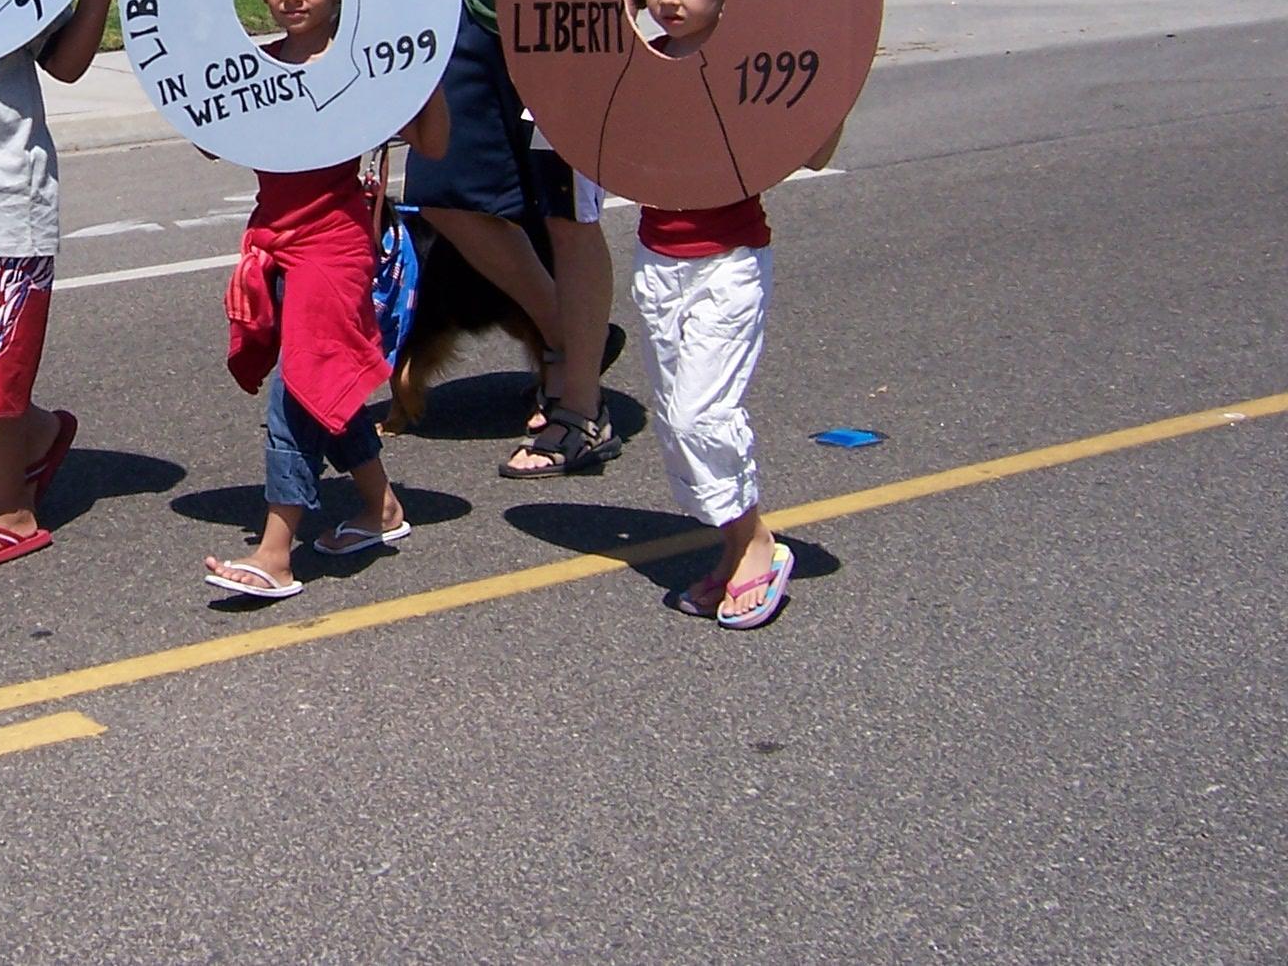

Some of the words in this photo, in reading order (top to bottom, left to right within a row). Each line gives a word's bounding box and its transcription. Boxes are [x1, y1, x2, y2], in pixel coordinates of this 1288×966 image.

[362, 28, 437, 78] 1999
[514, 1, 624, 53] LIBERTY
[157, 74, 188, 107] IN
[205, 53, 260, 90] GOD
[183, 95, 230, 127] WE
[231, 70, 308, 113] TRUST
[734, 49, 820, 109] 1999
